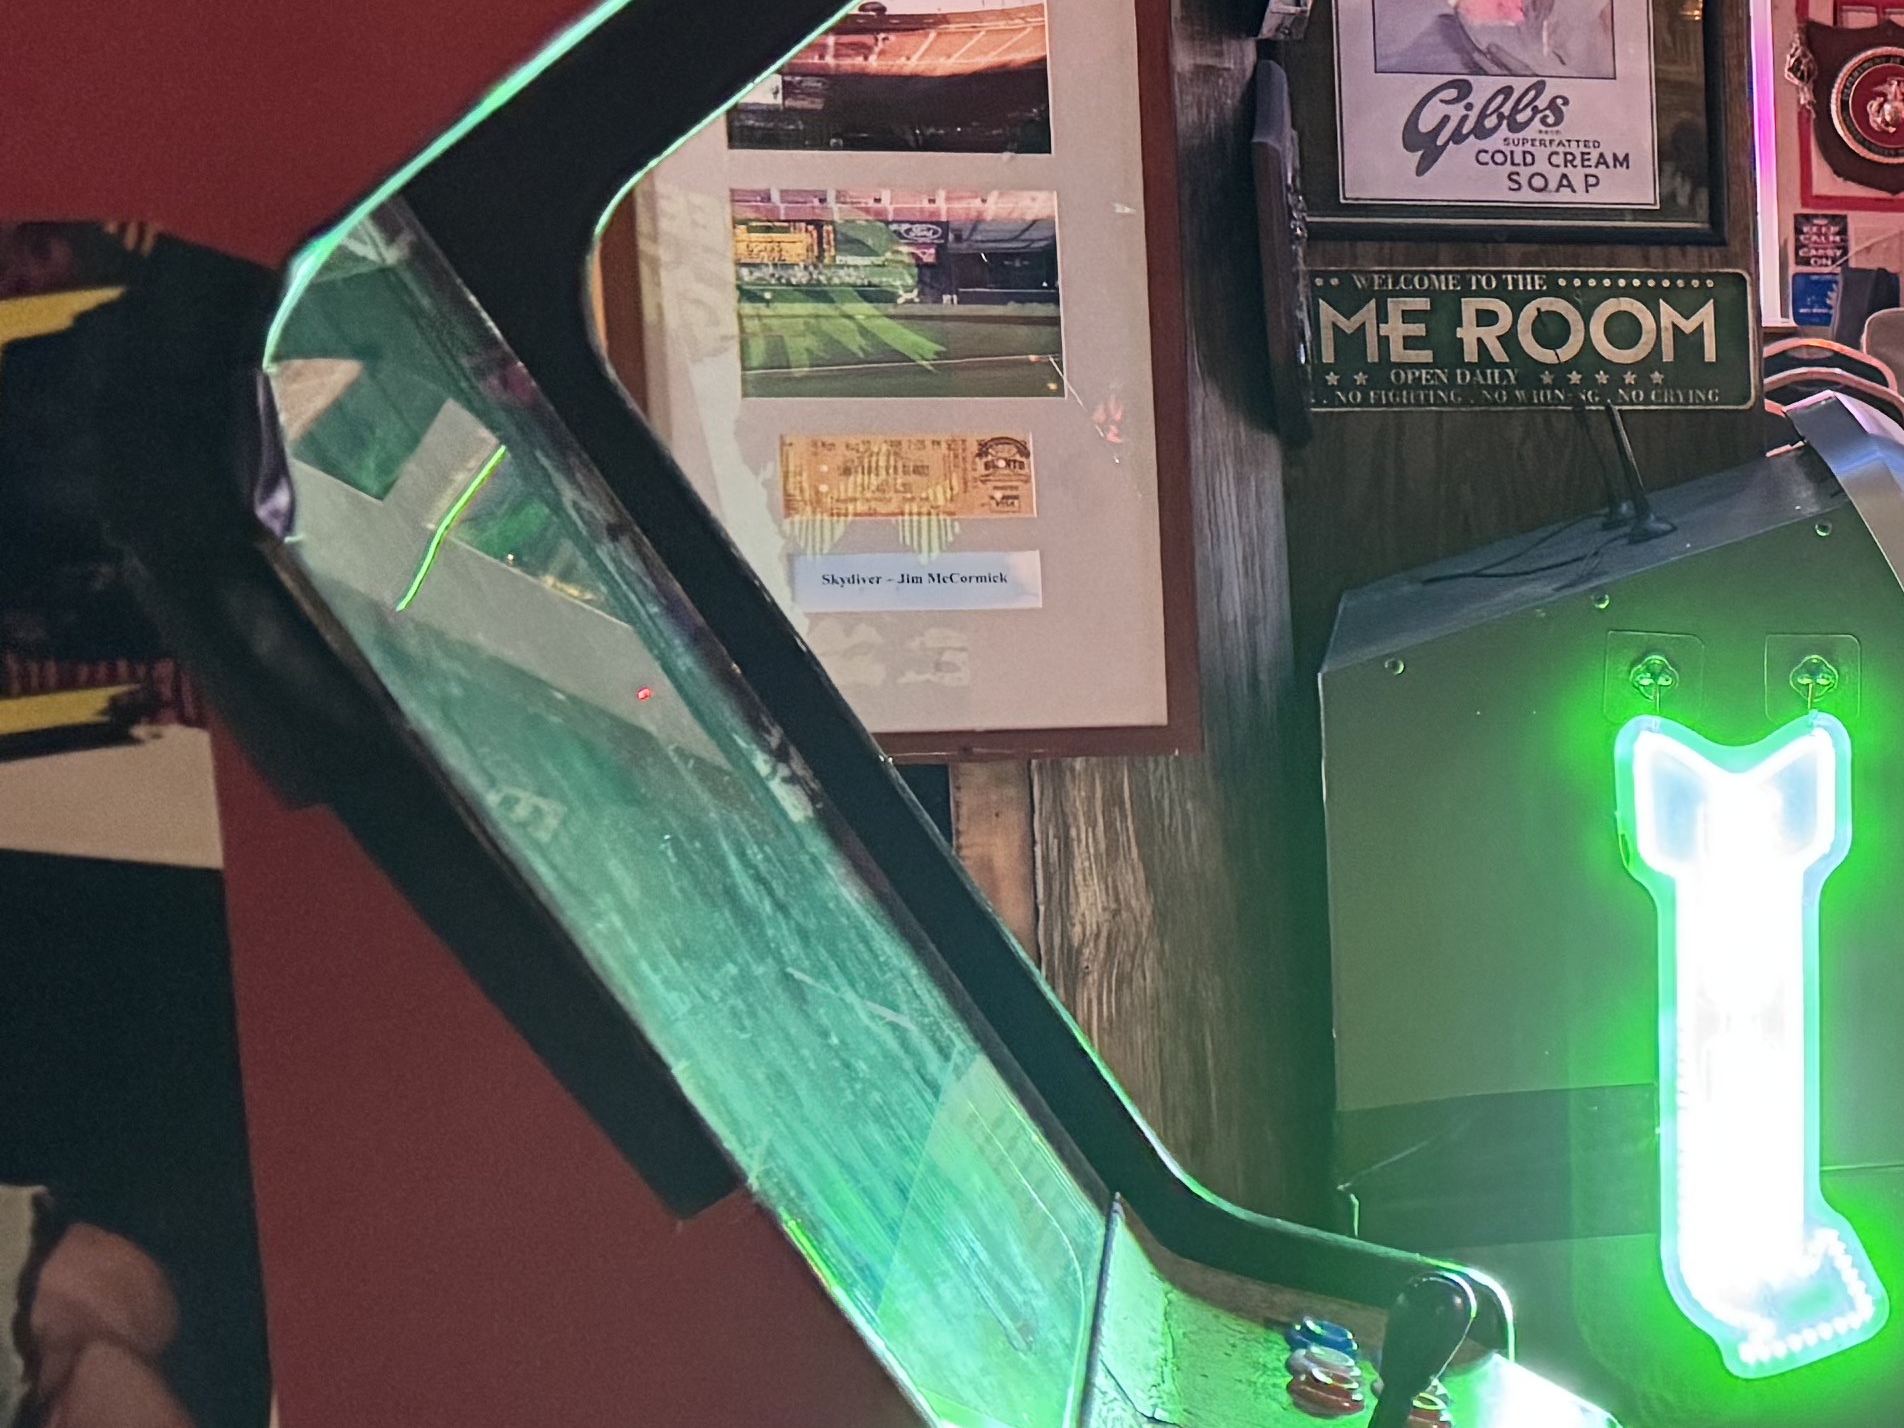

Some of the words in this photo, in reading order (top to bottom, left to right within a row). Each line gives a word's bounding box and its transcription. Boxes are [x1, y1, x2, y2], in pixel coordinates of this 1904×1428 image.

[1401, 78, 1570, 178] Gibbs
[1503, 137, 1601, 149] SUPERFATTED
[1475, 149, 1536, 168] COLD
[1547, 151, 1630, 171] CREAM
[1506, 171, 1601, 195] SOAP
[1809, 256, 1833, 268] ON
[1353, 274, 1461, 291] WELCOME
[1466, 274, 1497, 291] TO
[1502, 274, 1547, 291] THE
[1455, 296, 1718, 365] ROOM
[1390, 368, 1450, 386] OPEN
[1455, 368, 1519, 386] DAILY
[1335, 389, 1363, 404] NO
[1617, 388, 1645, 404] NO
[1650, 388, 1720, 404] CRYING
[821, 573, 882, 588] Skydiver
[896, 572, 923, 586] Jim
[927, 571, 1009, 586] McCormick
